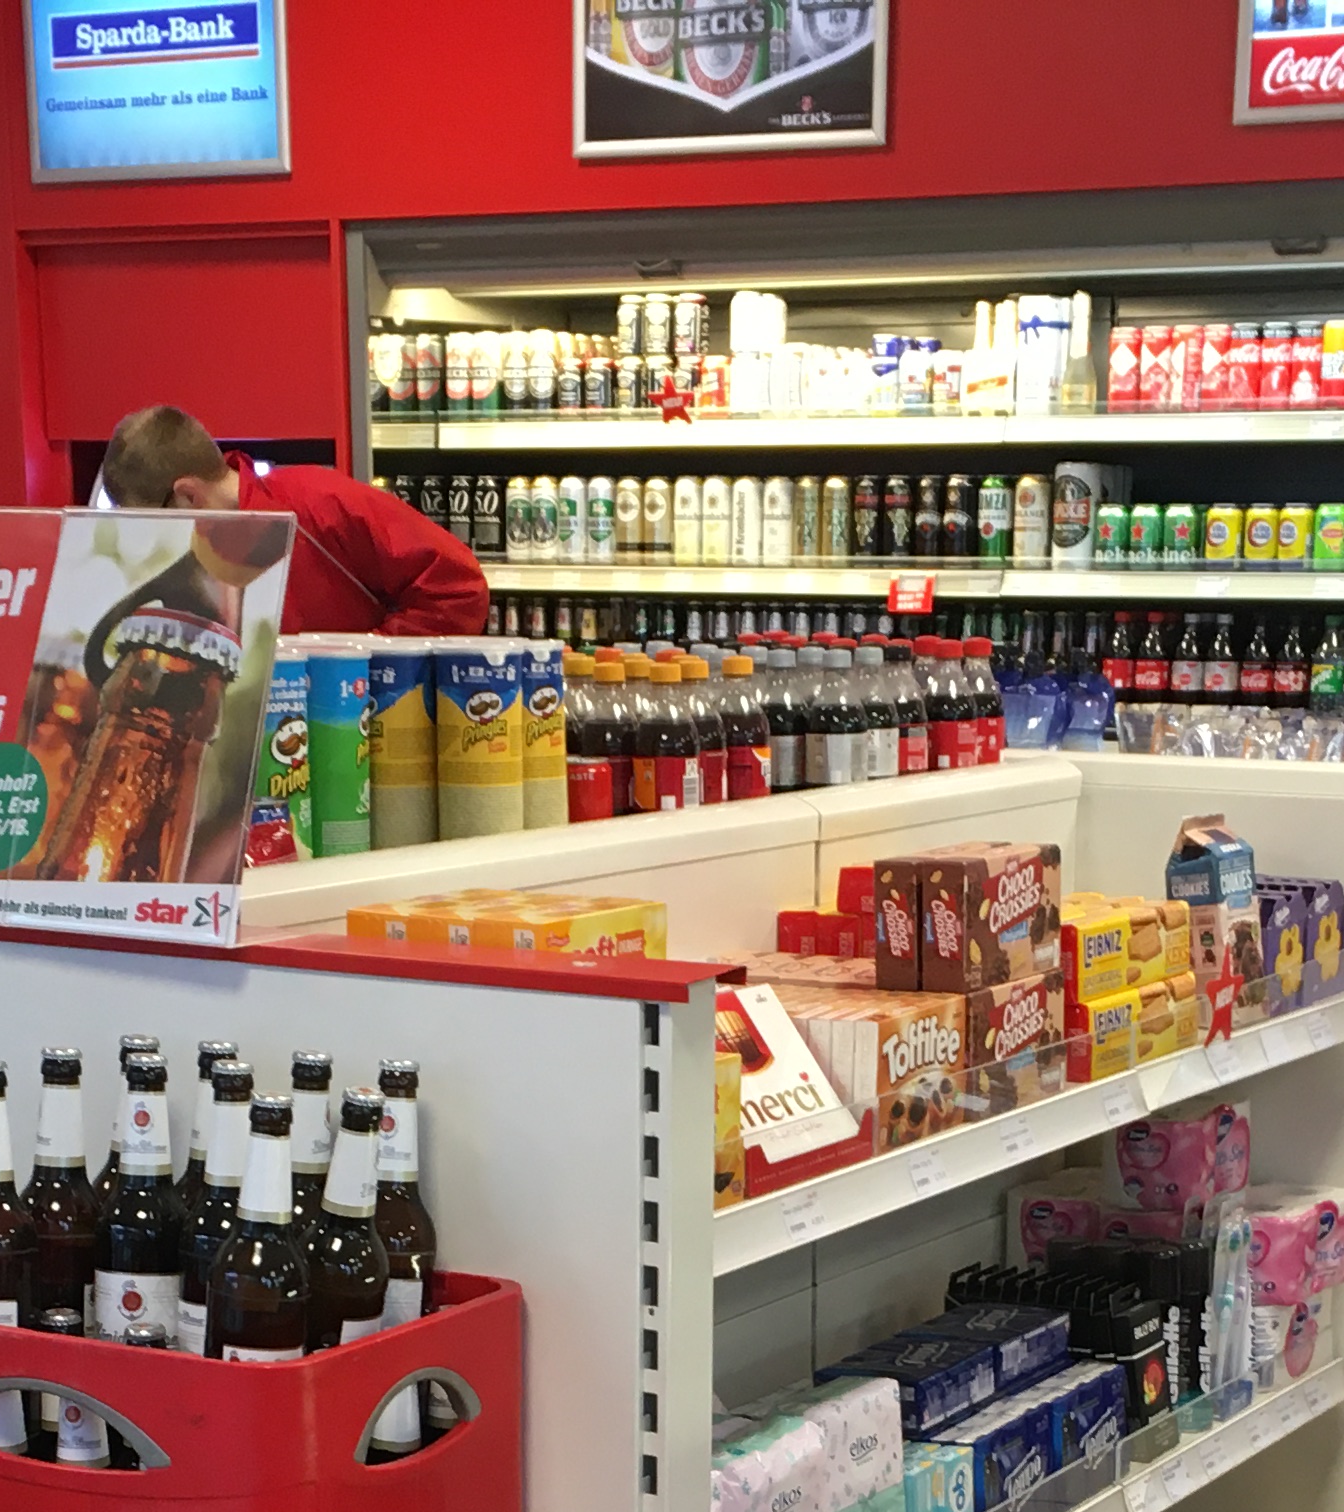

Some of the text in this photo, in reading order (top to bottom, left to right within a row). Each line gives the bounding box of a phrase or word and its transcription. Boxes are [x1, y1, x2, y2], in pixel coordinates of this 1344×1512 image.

[75, 13, 235, 54] Sparda-Bank
[678, 9, 765, 39] BECK'S
[46, 86, 268, 114] Gemeinsam mehr als eine Bank
[781, 110, 832, 127] BECK'S
[736, 491, 746, 545] Krombacher
[462, 720, 508, 751] Pringles
[268, 765, 310, 798] Pring
[8, 796, 40, 815] Erst
[997, 865, 1034, 903] CHOCO
[1171, 880, 1210, 898] COOKIES
[1219, 870, 1253, 895] COOKIES
[24, 900, 38, 916] als
[40, 901, 81, 921] günstig
[83, 903, 128, 920] tanken!
[135, 899, 188, 926] star
[989, 882, 1041, 933] CROSSIES
[895, 909, 910, 951] CHOCO
[930, 899, 950, 958] CROSSIES
[944, 909, 958, 952] CHOCO
[1083, 929, 1122, 968] LEIBNIZ
[1003, 991, 1038, 1030] CHOCO
[1094, 1003, 1133, 1046] LEIBNIZ
[882, 1014, 961, 1085] Toffifee
[995, 1008, 1045, 1062] CROSSIES
[849, 1432, 880, 1457] elkos
[1005, 1444, 1046, 1512] Tempo
[771, 1485, 803, 1512] elkos
